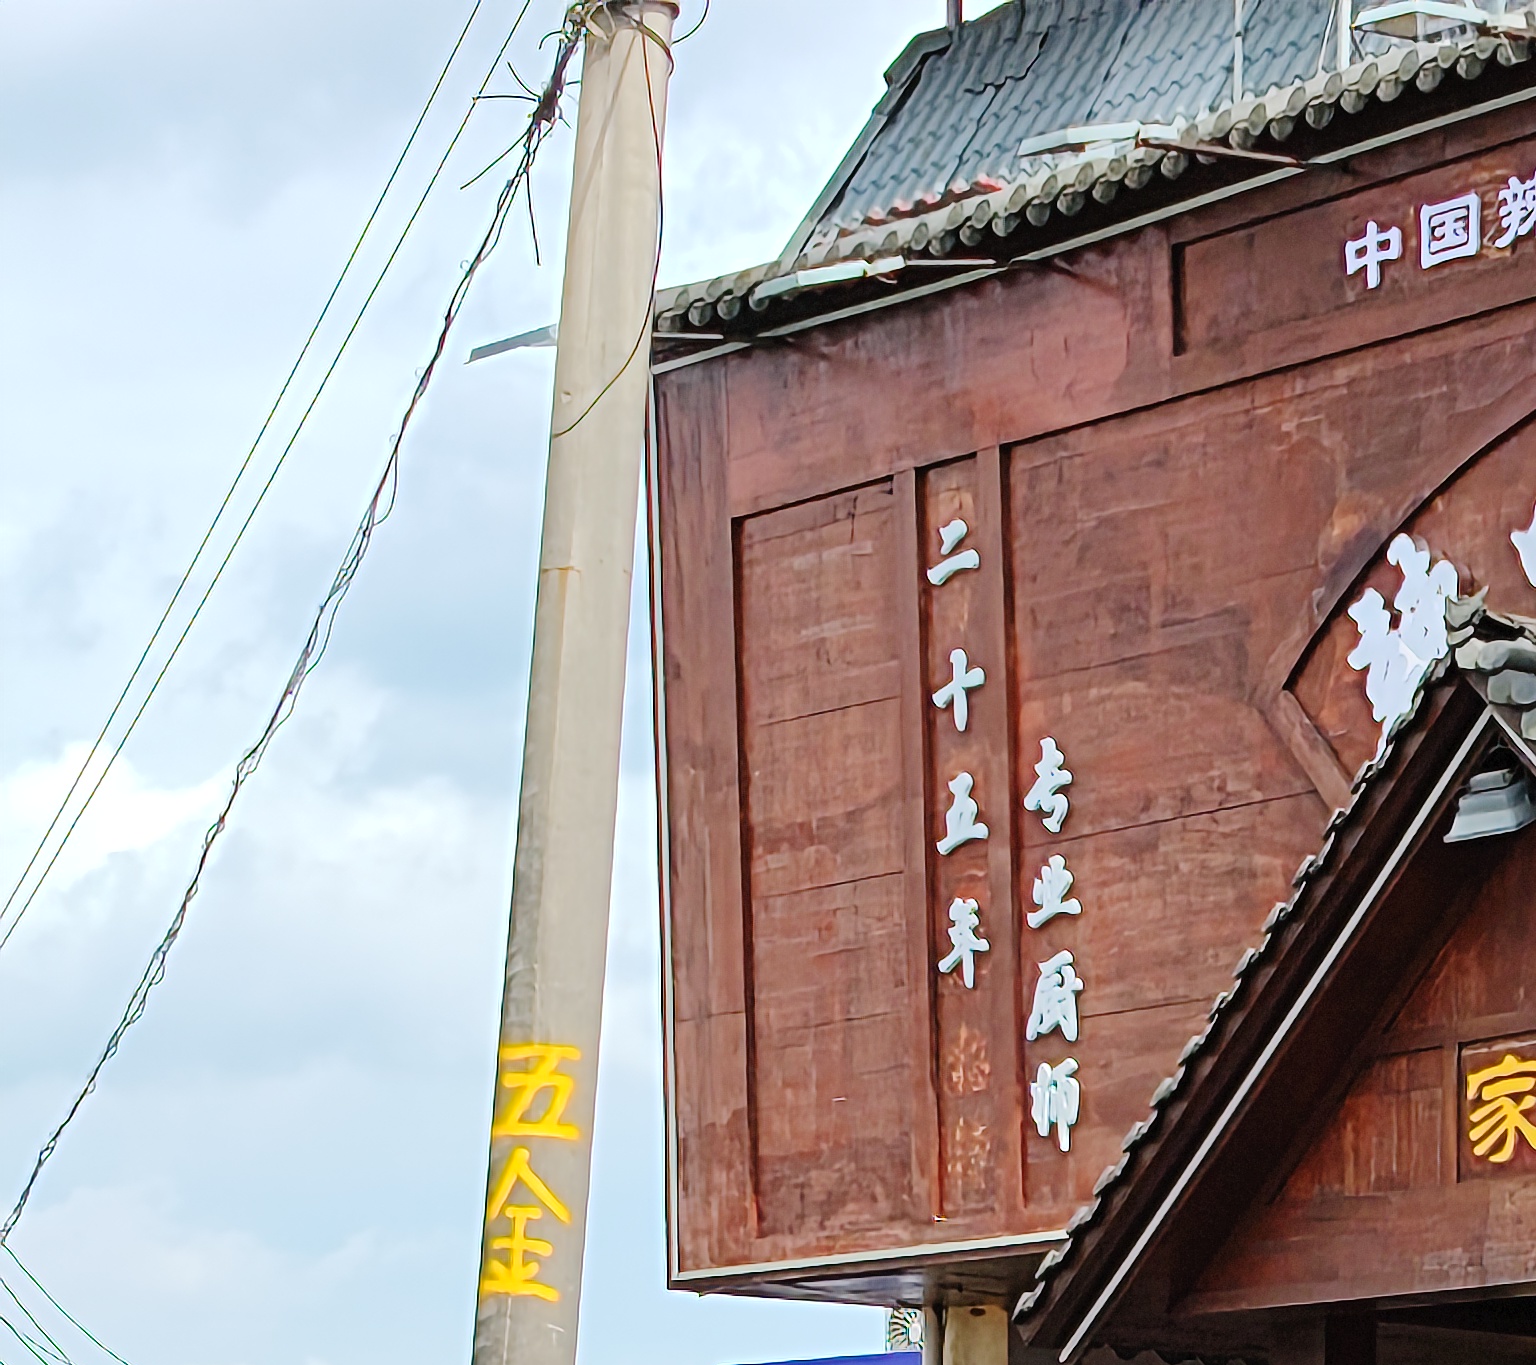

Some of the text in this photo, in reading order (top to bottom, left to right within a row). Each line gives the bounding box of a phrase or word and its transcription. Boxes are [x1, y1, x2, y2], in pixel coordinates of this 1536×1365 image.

[926, 519, 990, 989] 二十五年
[1023, 736, 1084, 1152] 专业厨师
[481, 1042, 582, 1302] 五金
